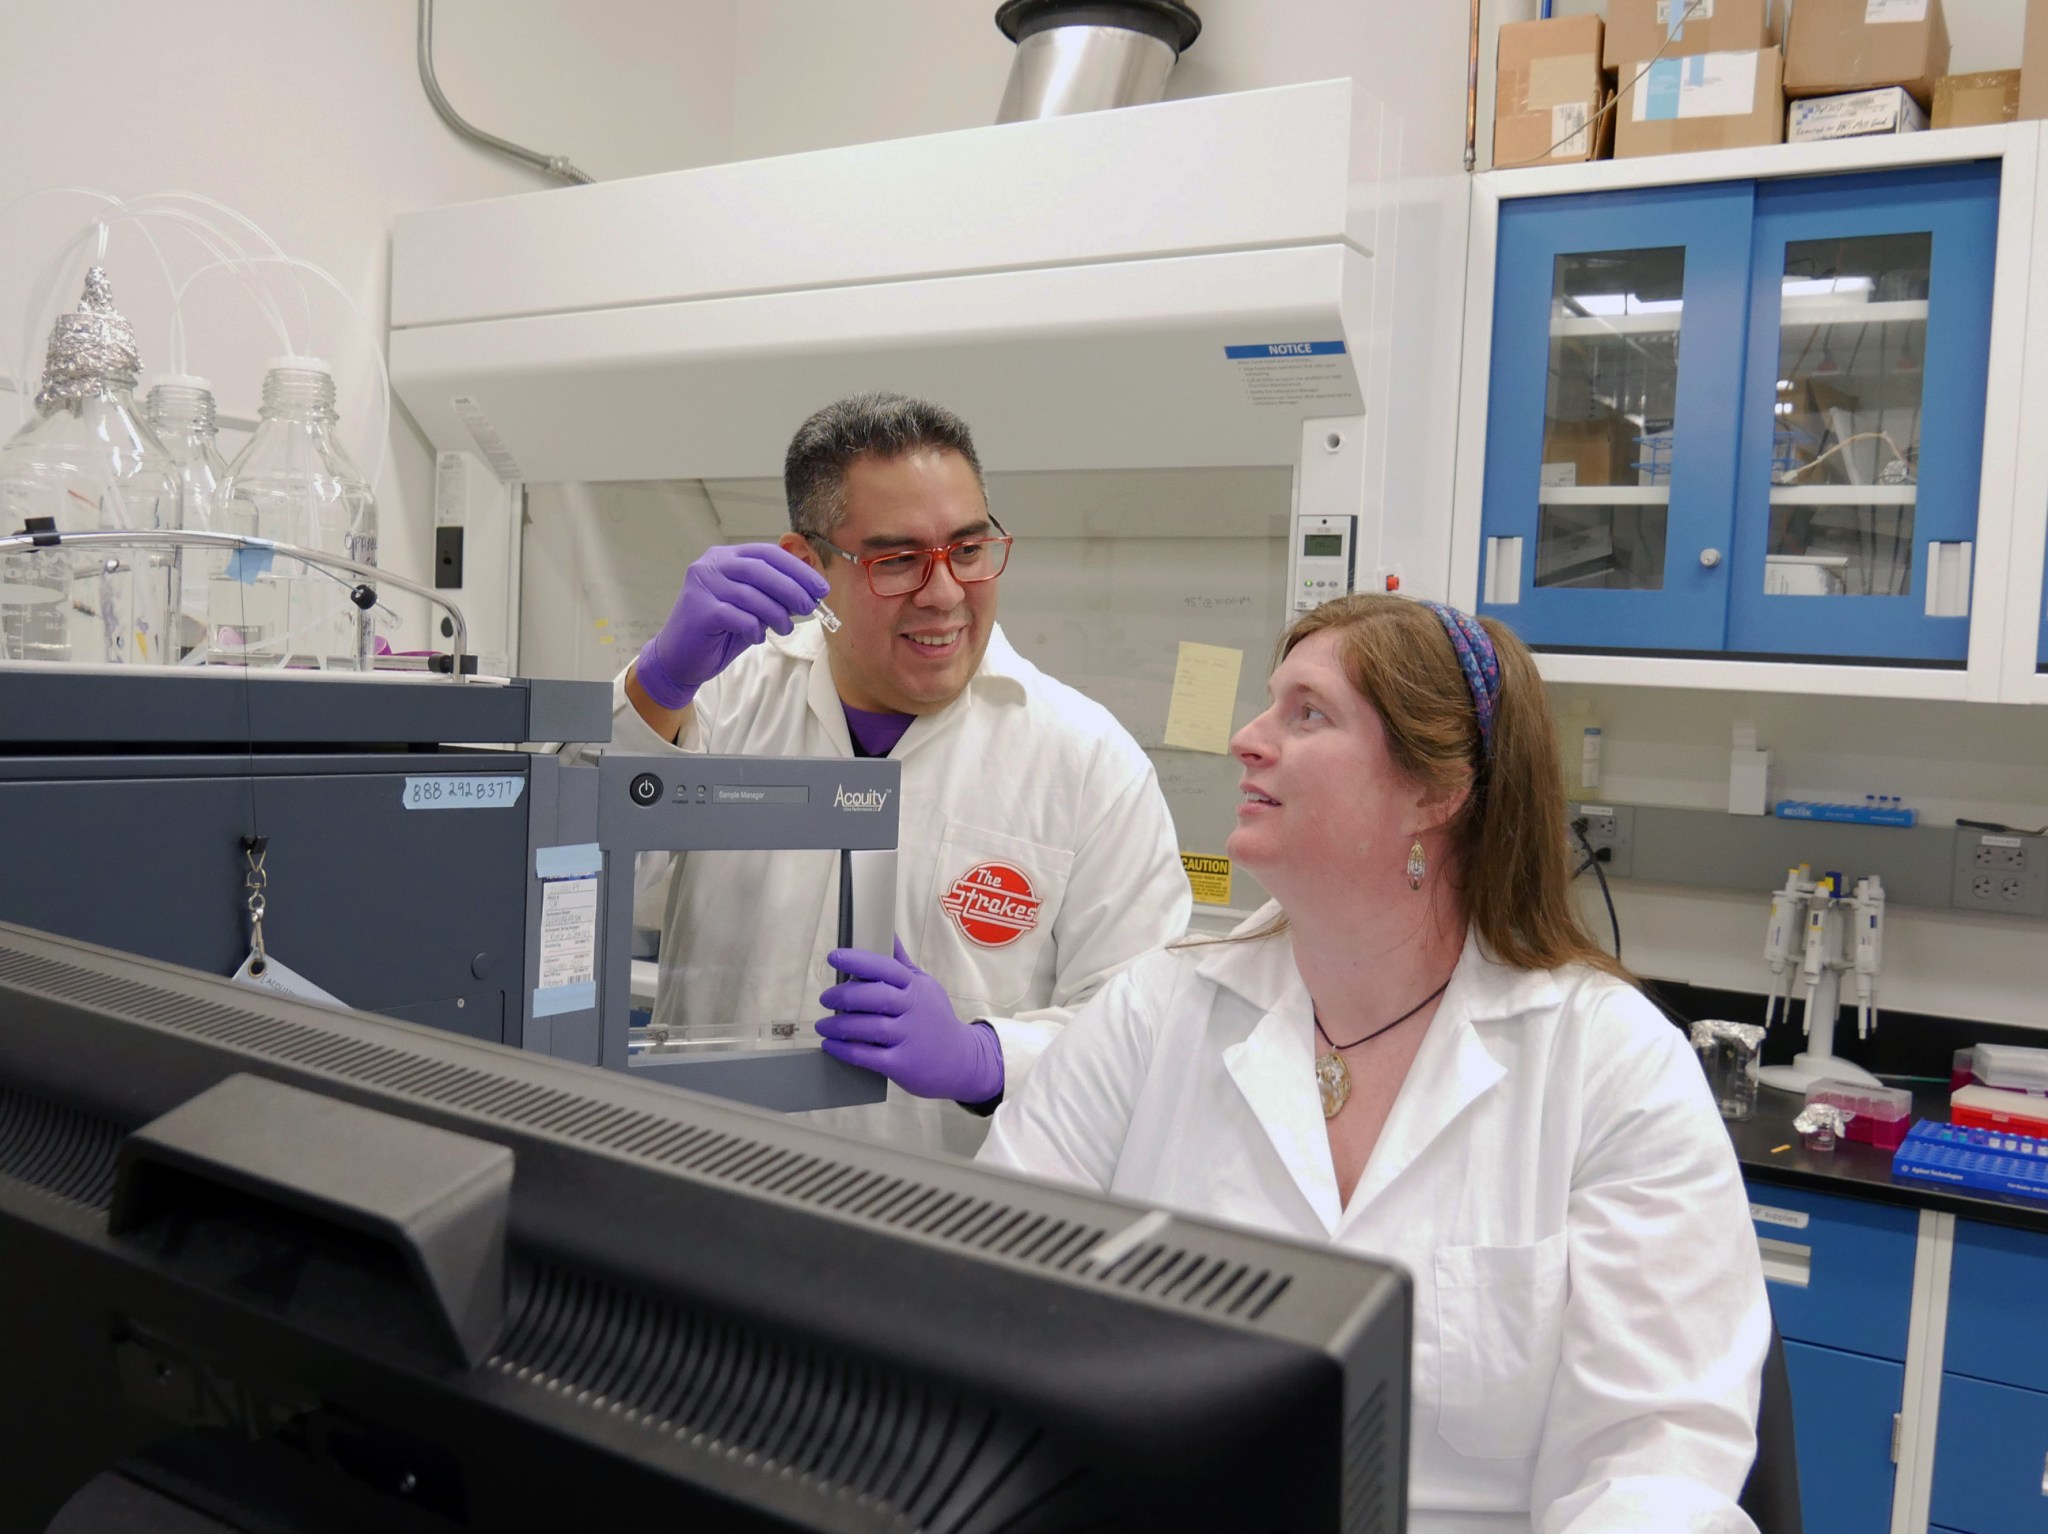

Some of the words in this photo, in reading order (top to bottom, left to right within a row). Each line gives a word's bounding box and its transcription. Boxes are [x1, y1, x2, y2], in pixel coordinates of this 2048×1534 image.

[1268, 343, 1312, 355] NOTICE
[412, 782, 442, 803] 888
[448, 781, 473, 797] 292
[718, 790, 740, 799] Sample
[740, 791, 765, 801] Manager
[1181, 857, 1228, 873] CAUTION
[976, 868, 1002, 888] The
[948, 879, 1038, 921] Strokes
